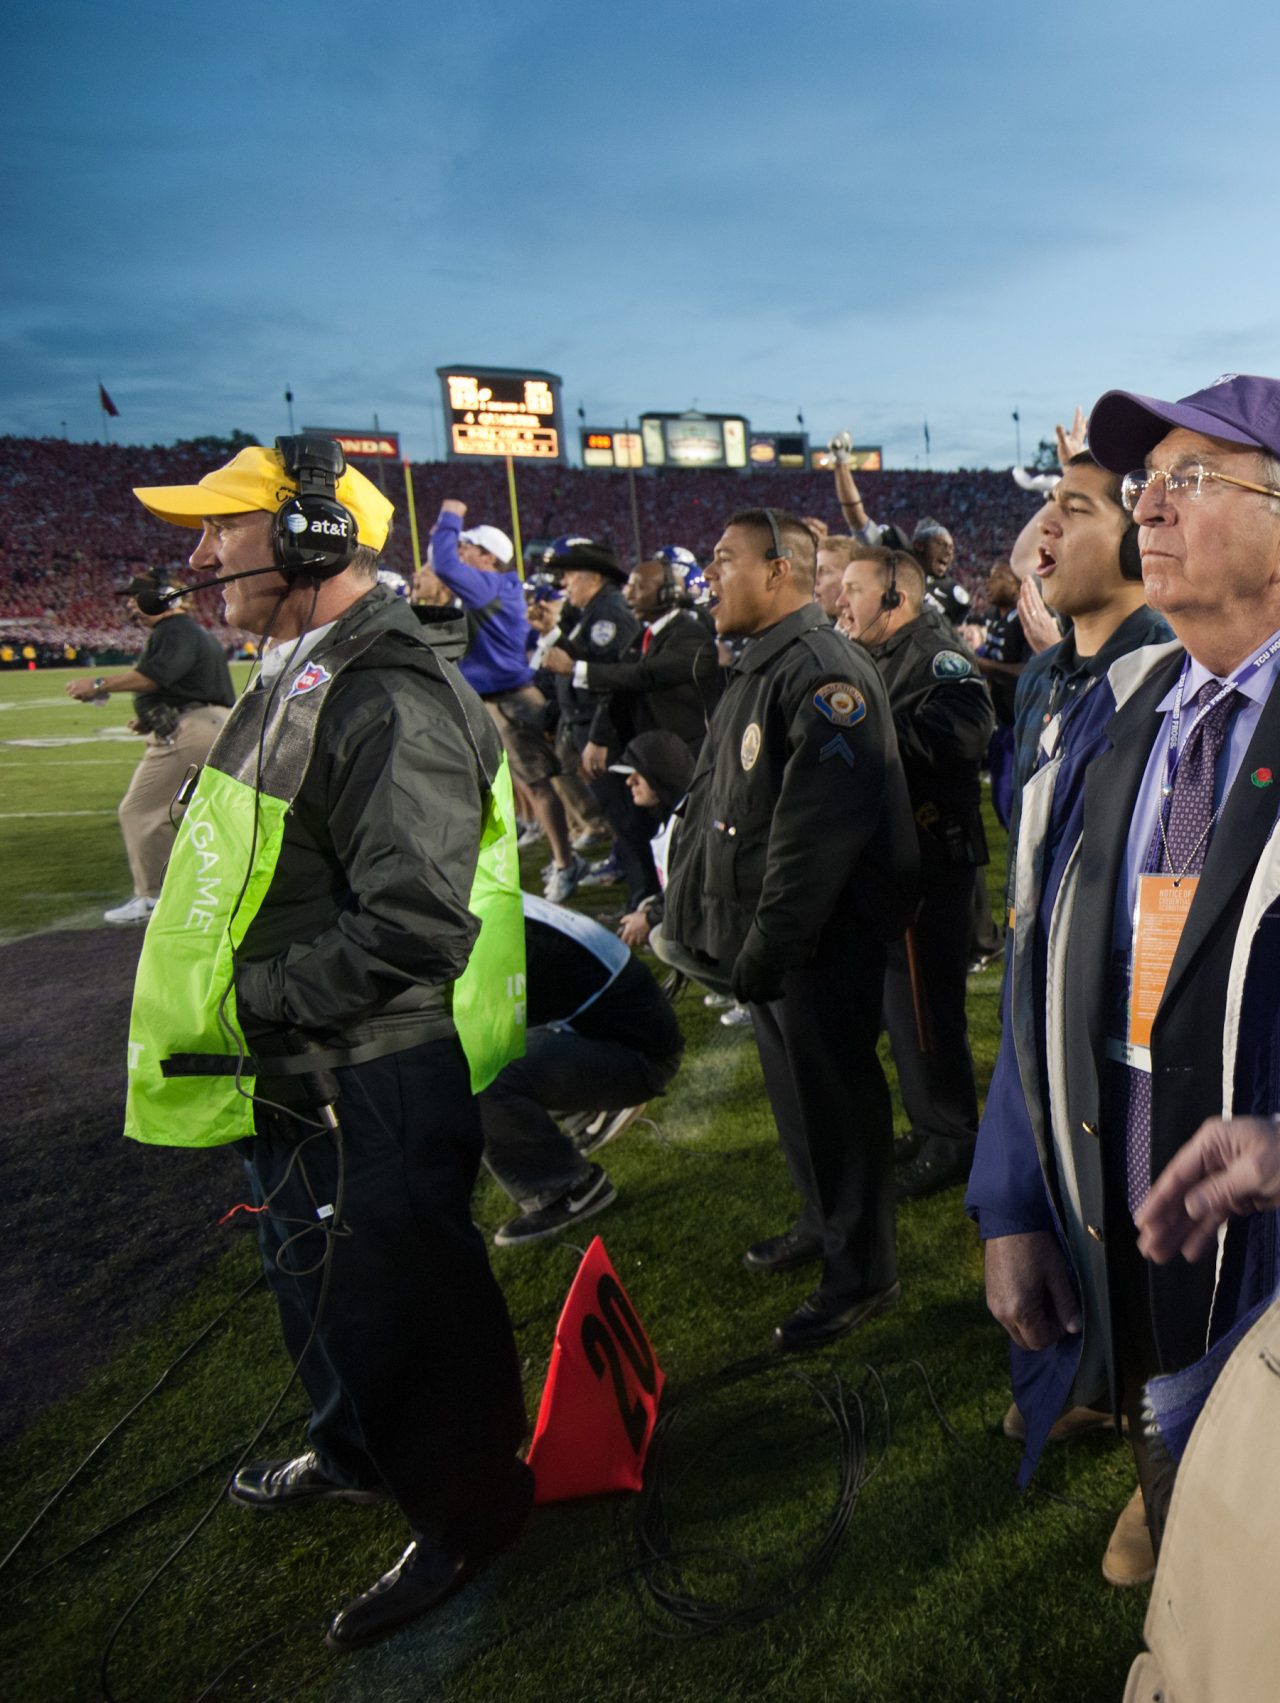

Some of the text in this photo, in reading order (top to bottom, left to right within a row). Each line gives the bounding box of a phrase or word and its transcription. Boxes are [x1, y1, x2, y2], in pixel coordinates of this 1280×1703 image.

[310, 519, 348, 538] at&t
[1252, 650, 1271, 668] TCU
[183, 820, 222, 935] GAME
[580, 1272, 658, 1456] 20
